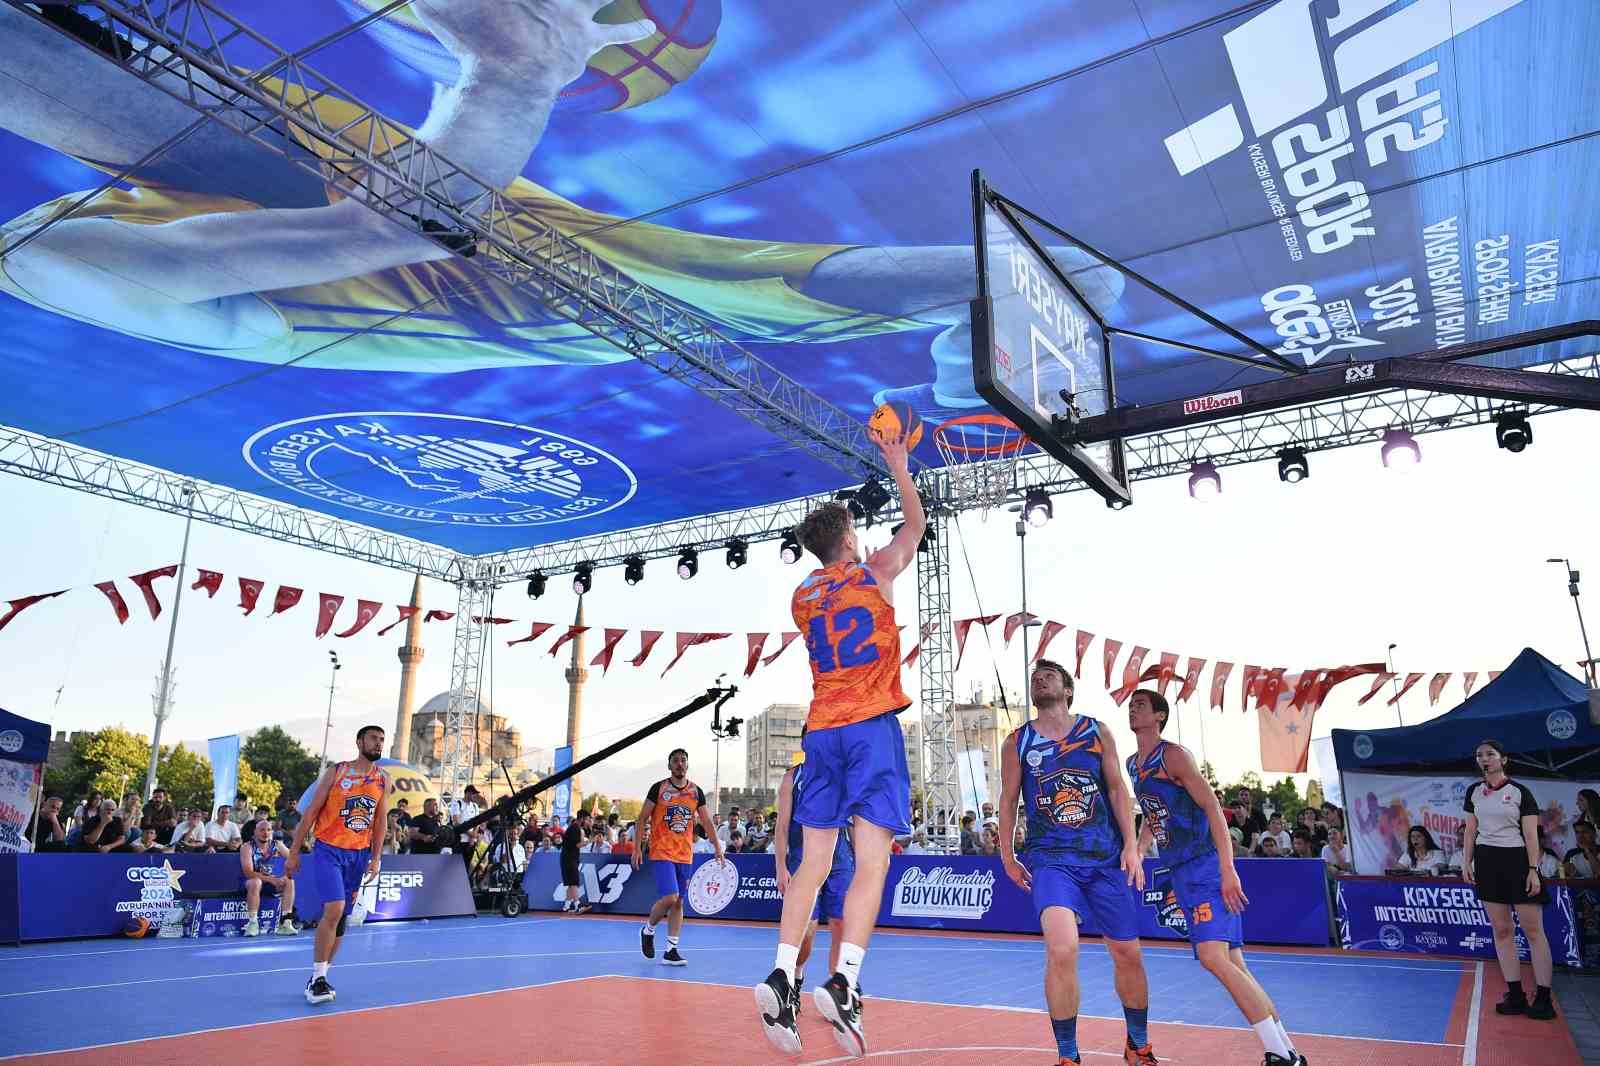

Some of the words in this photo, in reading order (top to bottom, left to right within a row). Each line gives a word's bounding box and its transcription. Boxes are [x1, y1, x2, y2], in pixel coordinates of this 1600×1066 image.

[1184, 395, 1239, 414] Wilson
[808, 606, 881, 673] 12
[128, 868, 169, 880] aces
[380, 874, 424, 888] SPOR
[143, 889, 173, 900] 2024
[738, 889, 763, 899] SPOR
[1145, 892, 1163, 902] 3X3
[1374, 905, 1492, 926] INTERNATIONAL
